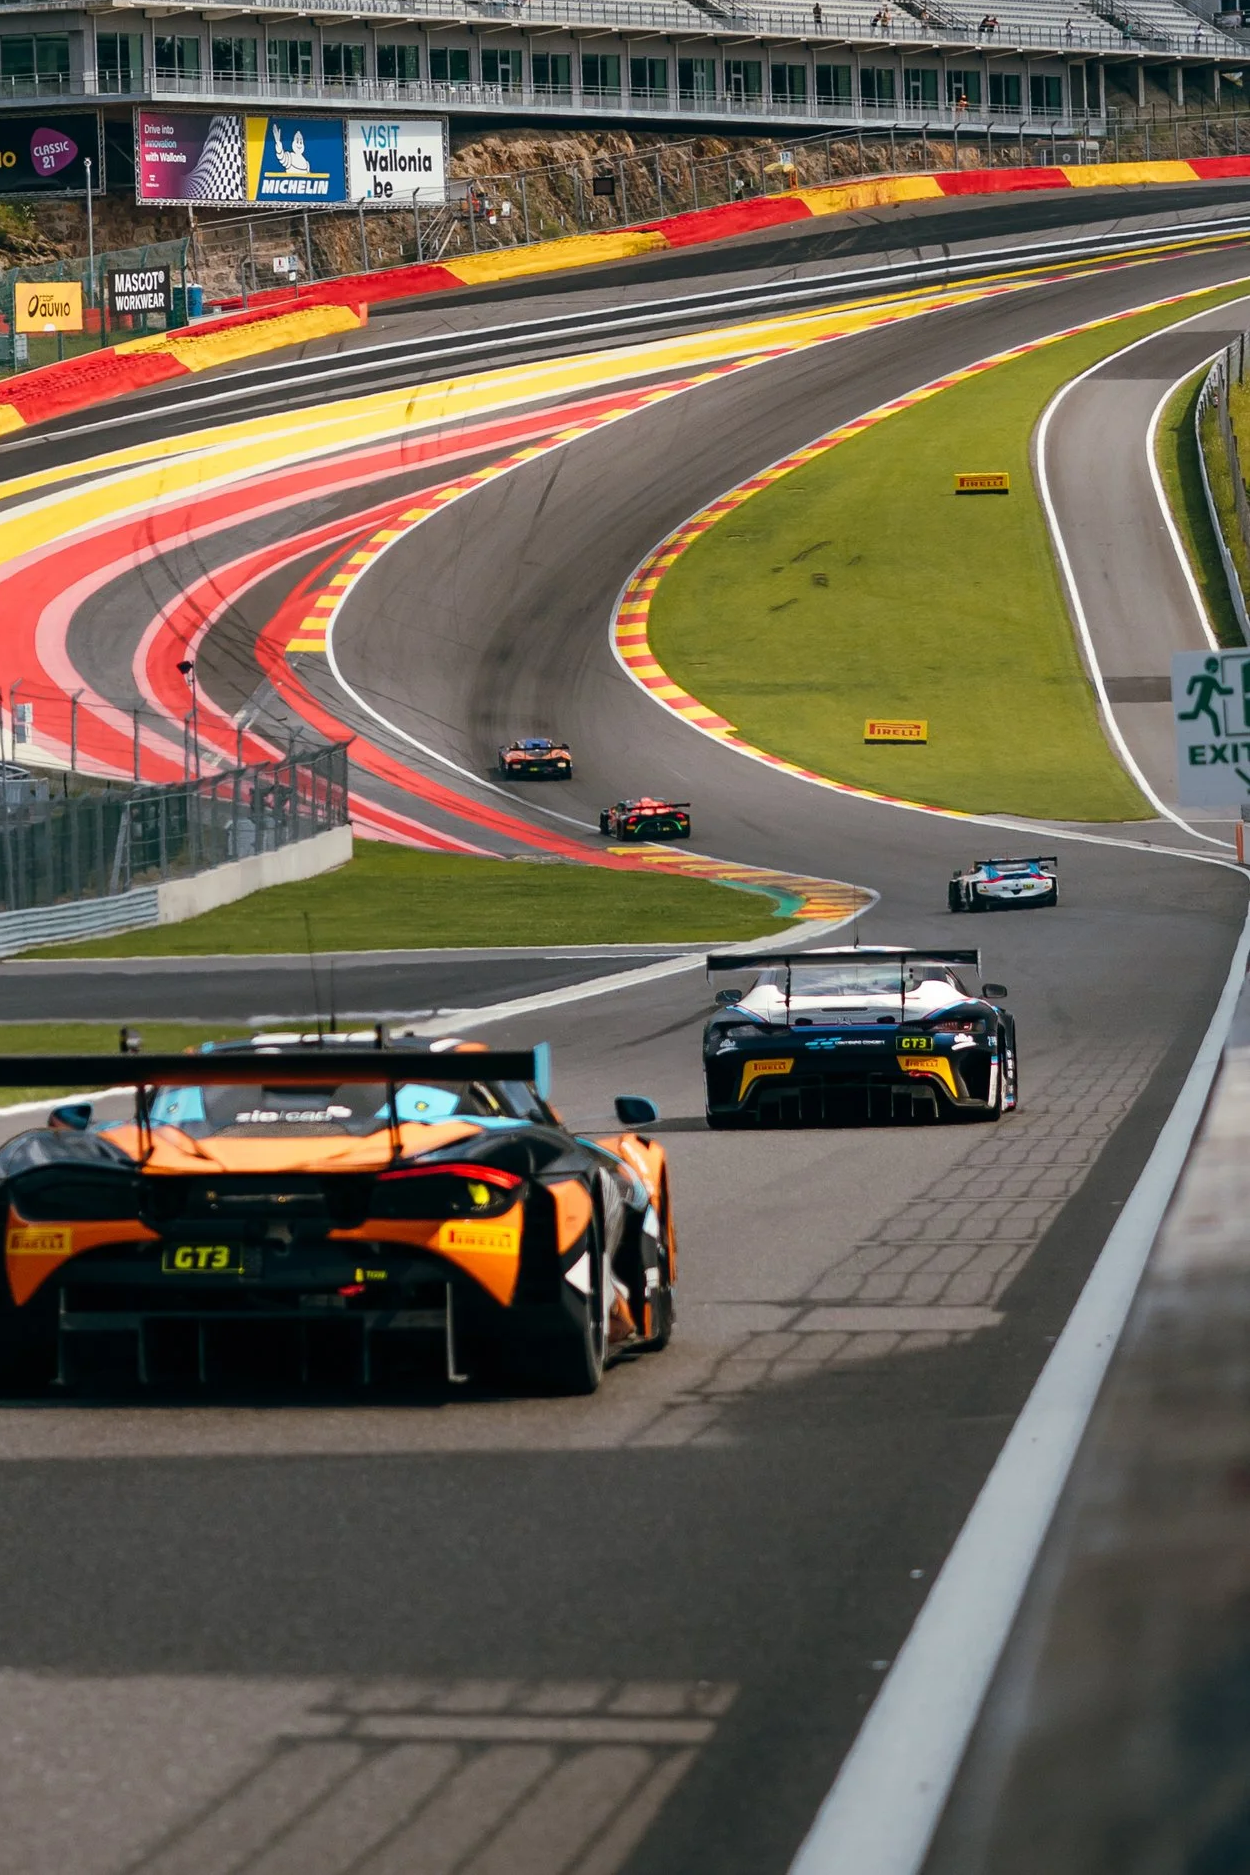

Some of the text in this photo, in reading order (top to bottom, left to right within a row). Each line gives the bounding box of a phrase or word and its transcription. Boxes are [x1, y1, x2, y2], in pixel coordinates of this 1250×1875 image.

[145, 124, 174, 135] Drive into
[361, 125, 399, 148] VISIT
[33, 140, 70, 157] CLASSIC
[42, 155, 55, 169] 21
[145, 152, 186, 163] with Wallonia
[363, 147, 432, 172] Wallonia
[261, 179, 329, 195] MICHELIN
[367, 175, 393, 198] .be
[39, 302, 71, 317] auvio
[115, 293, 165, 311] WORKWEAR
[959, 476, 1004, 487] PIRELLI
[869, 723, 921, 737] PIRELLI
[901, 1038, 927, 1049] GT3
[753, 1061, 786, 1071] PIRELLI
[905, 1058, 938, 1067] PIRELLI
[10, 1233, 65, 1250] PIRELLI
[449, 1229, 511, 1248] PIRELLI
[174, 1245, 230, 1270] GT3
